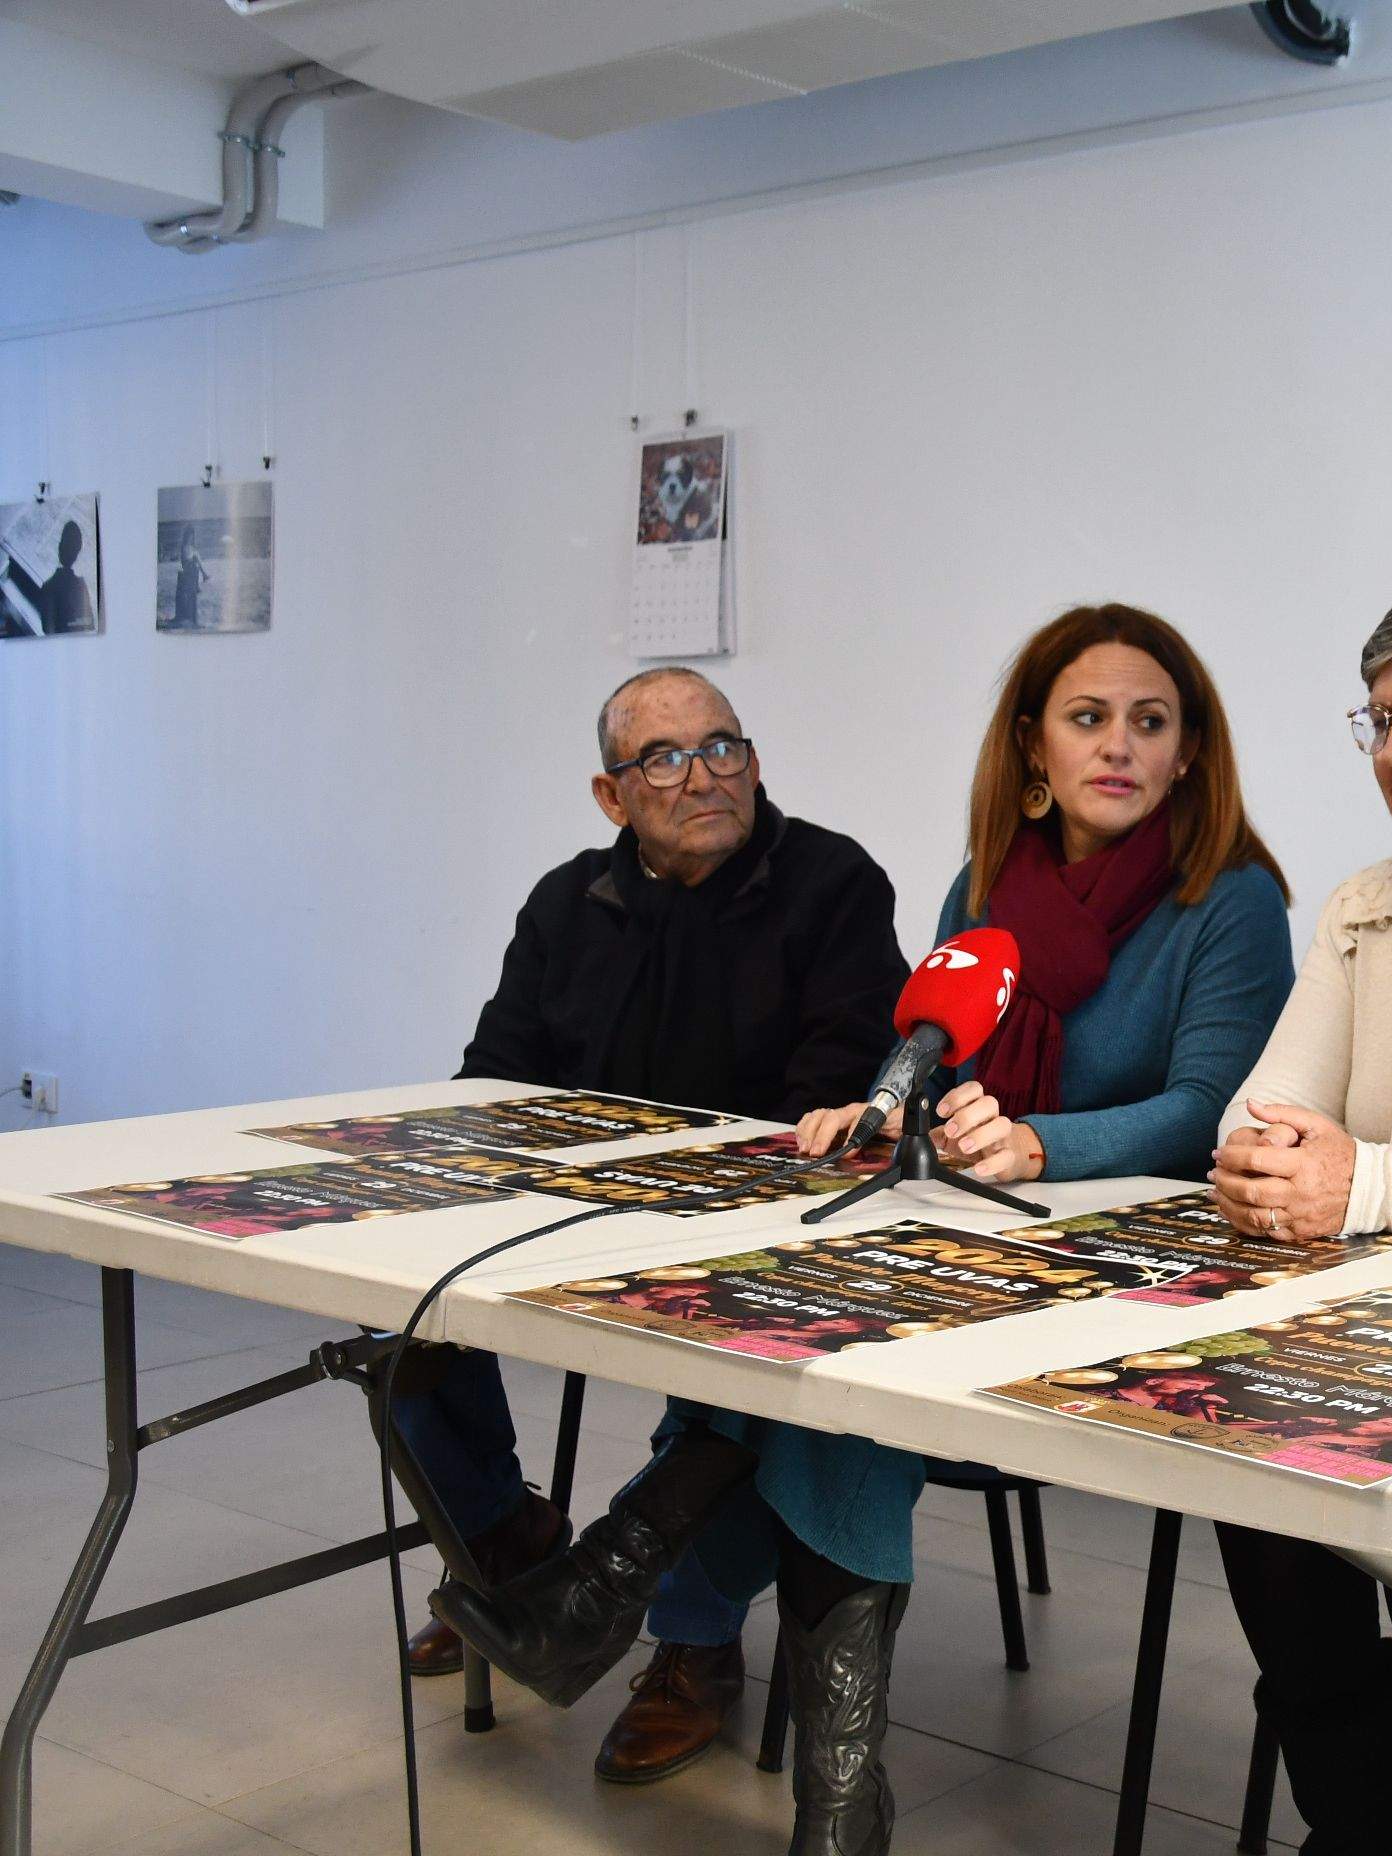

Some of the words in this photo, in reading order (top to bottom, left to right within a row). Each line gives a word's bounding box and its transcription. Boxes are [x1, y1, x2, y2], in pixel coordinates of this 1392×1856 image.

[389, 1162, 453, 1175] PRE
[594, 1170, 679, 1192] UVAS
[1188, 1235, 1231, 1245] 29
[853, 1250, 934, 1270] PRE
[930, 1266, 1040, 1292] UVAS
[881, 1238, 1100, 1284] 2024
[846, 1280, 892, 1291] 29
[732, 1292, 798, 1307] 22:30
[794, 1304, 840, 1317] PM
[1283, 1347, 1346, 1363] VIERNES
[1215, 1362, 1319, 1388] Ernesto
[1243, 1383, 1325, 1403] 22:30
[1324, 1400, 1380, 1415] PM
